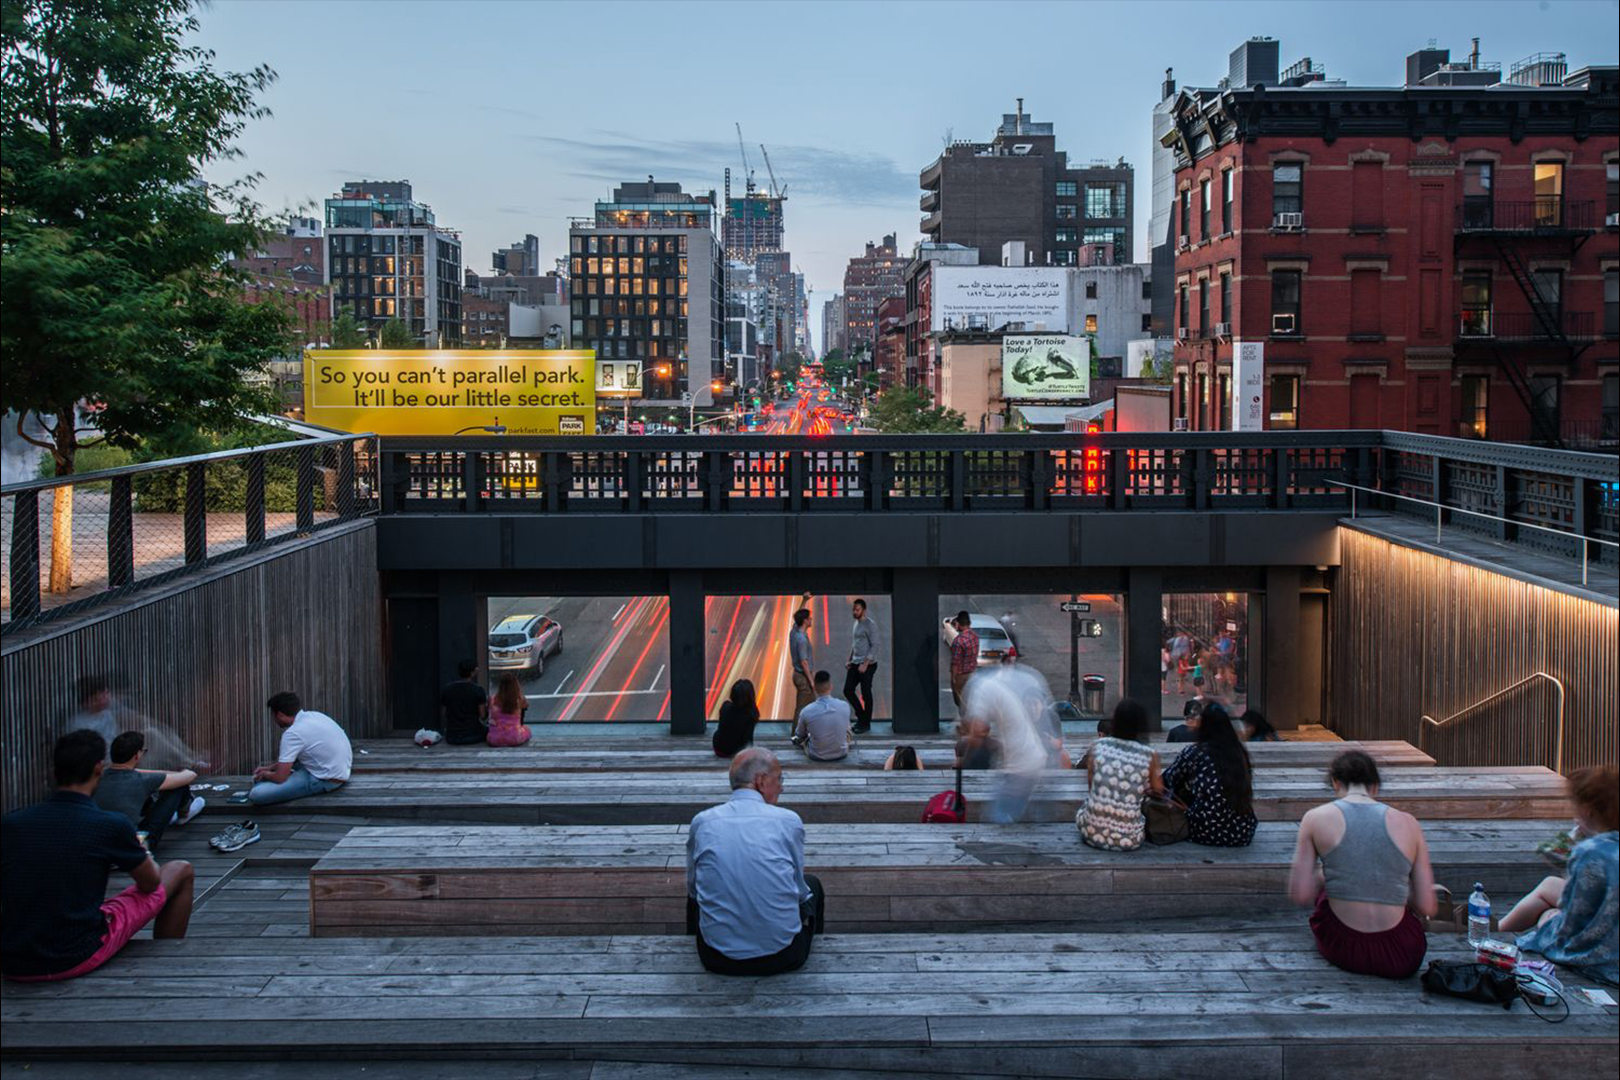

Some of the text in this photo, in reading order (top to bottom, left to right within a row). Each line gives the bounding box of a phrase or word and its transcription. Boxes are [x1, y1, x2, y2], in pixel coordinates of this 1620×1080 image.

[1005, 338, 1025, 346] Love
[1033, 338, 1066, 346] Tortoise
[1005, 346, 1033, 354] Today!
[321, 366, 586, 389] So you can't parallel park.
[354, 390, 586, 407] It'll be our little secret.
[508, 426, 556, 434] parkfast.com
